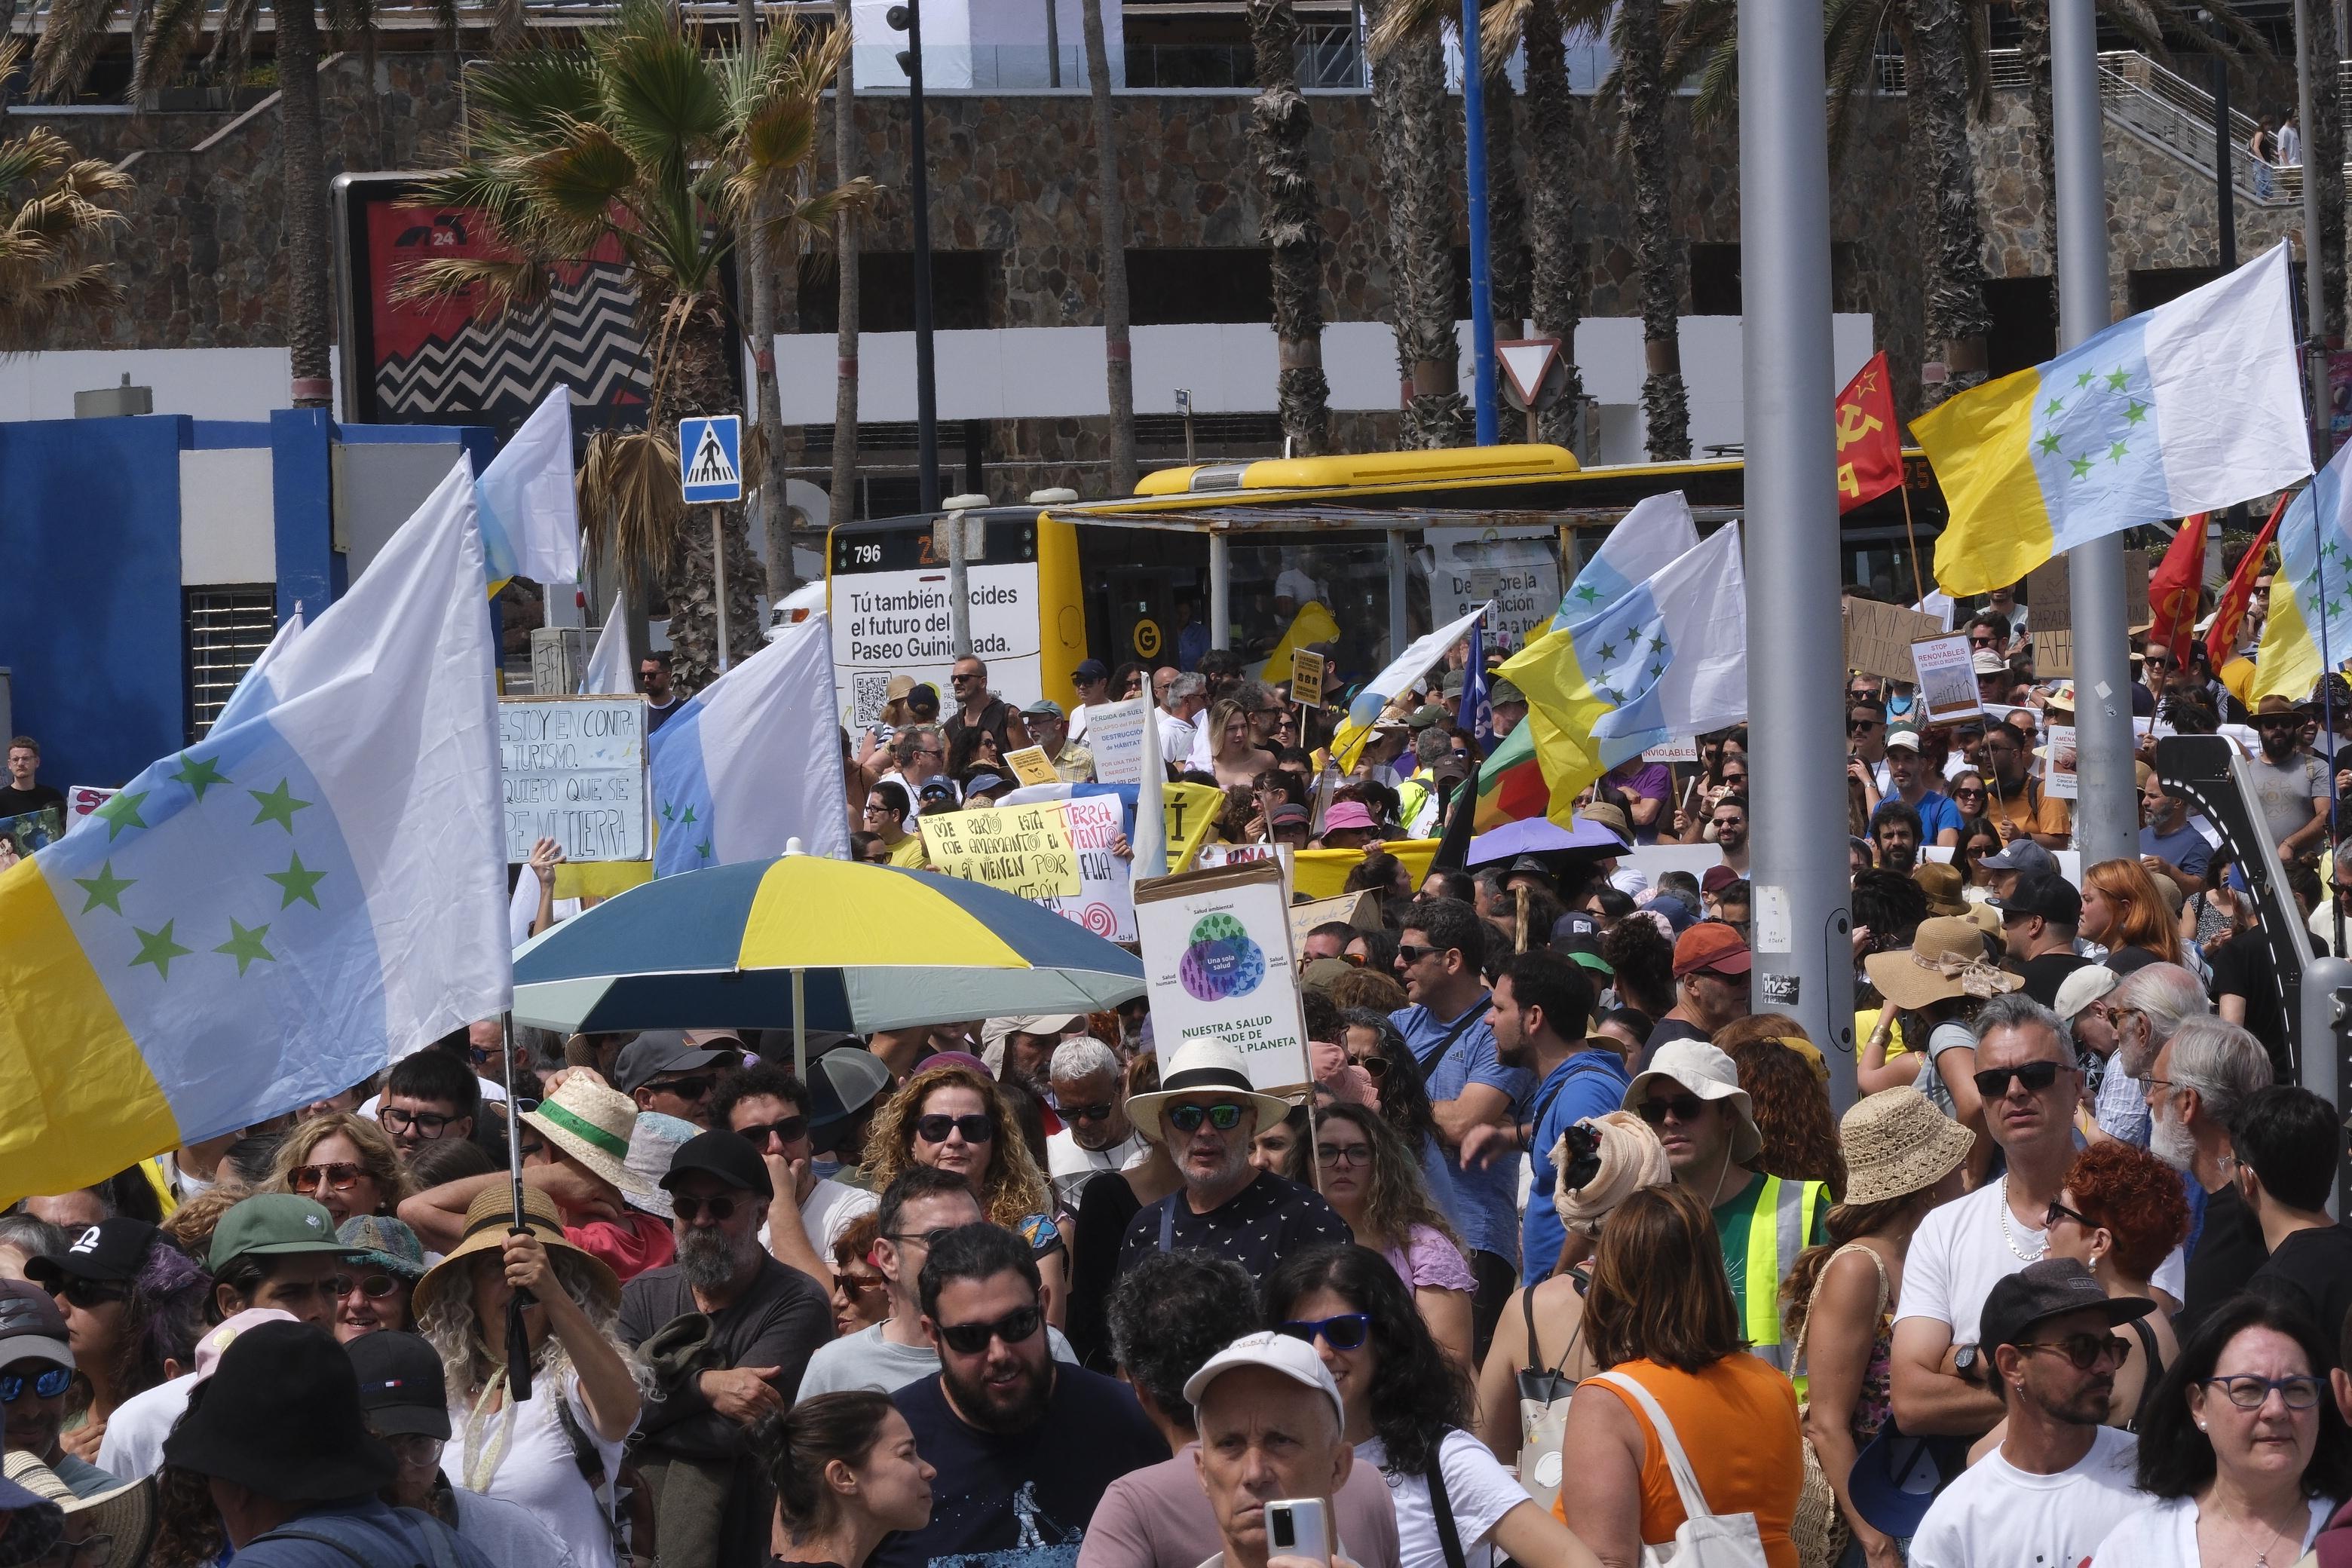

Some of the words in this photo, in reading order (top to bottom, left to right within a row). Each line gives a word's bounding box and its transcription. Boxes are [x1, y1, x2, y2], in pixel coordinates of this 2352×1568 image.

[433, 231, 454, 246] 24
[854, 544, 881, 564] 796
[1524, 571, 1536, 589] la
[850, 590, 871, 613] Tú
[874, 588, 945, 611] también
[851, 617, 865, 636] el
[868, 615, 921, 636] futuro
[925, 612, 950, 632] del
[852, 640, 903, 660] Paseo
[1918, 648, 1965, 662] RENOVABLES
[1931, 643, 1948, 651] STOP
[499, 709, 551, 742] ESTOY
[556, 710, 582, 740] EN
[583, 709, 635, 737] CONTRA
[513, 743, 578, 771] TURISMO.
[1643, 749, 1696, 757] INVIOLABLES
[502, 778, 558, 804] QUIERO
[566, 778, 602, 802] QUE
[608, 778, 629, 801] SE
[563, 810, 626, 857] TIERRA
[933, 822, 956, 838] ME
[967, 812, 1002, 835] PARIÓ
[942, 841, 963, 855] ME
[969, 831, 1040, 854] AMAMANTÓ
[1048, 833, 1059, 850] EL
[1031, 853, 1070, 876] POR
[1208, 903, 1235, 913] ambiental
[1213, 962, 1231, 971] salud
[1156, 979, 1177, 988] humana
[1182, 1022, 1233, 1039] NUESTRA
[1236, 1015, 1272, 1030] SALUD
[1248, 1030, 1263, 1040] DE
[1247, 1037, 1297, 1053] PLANETA
